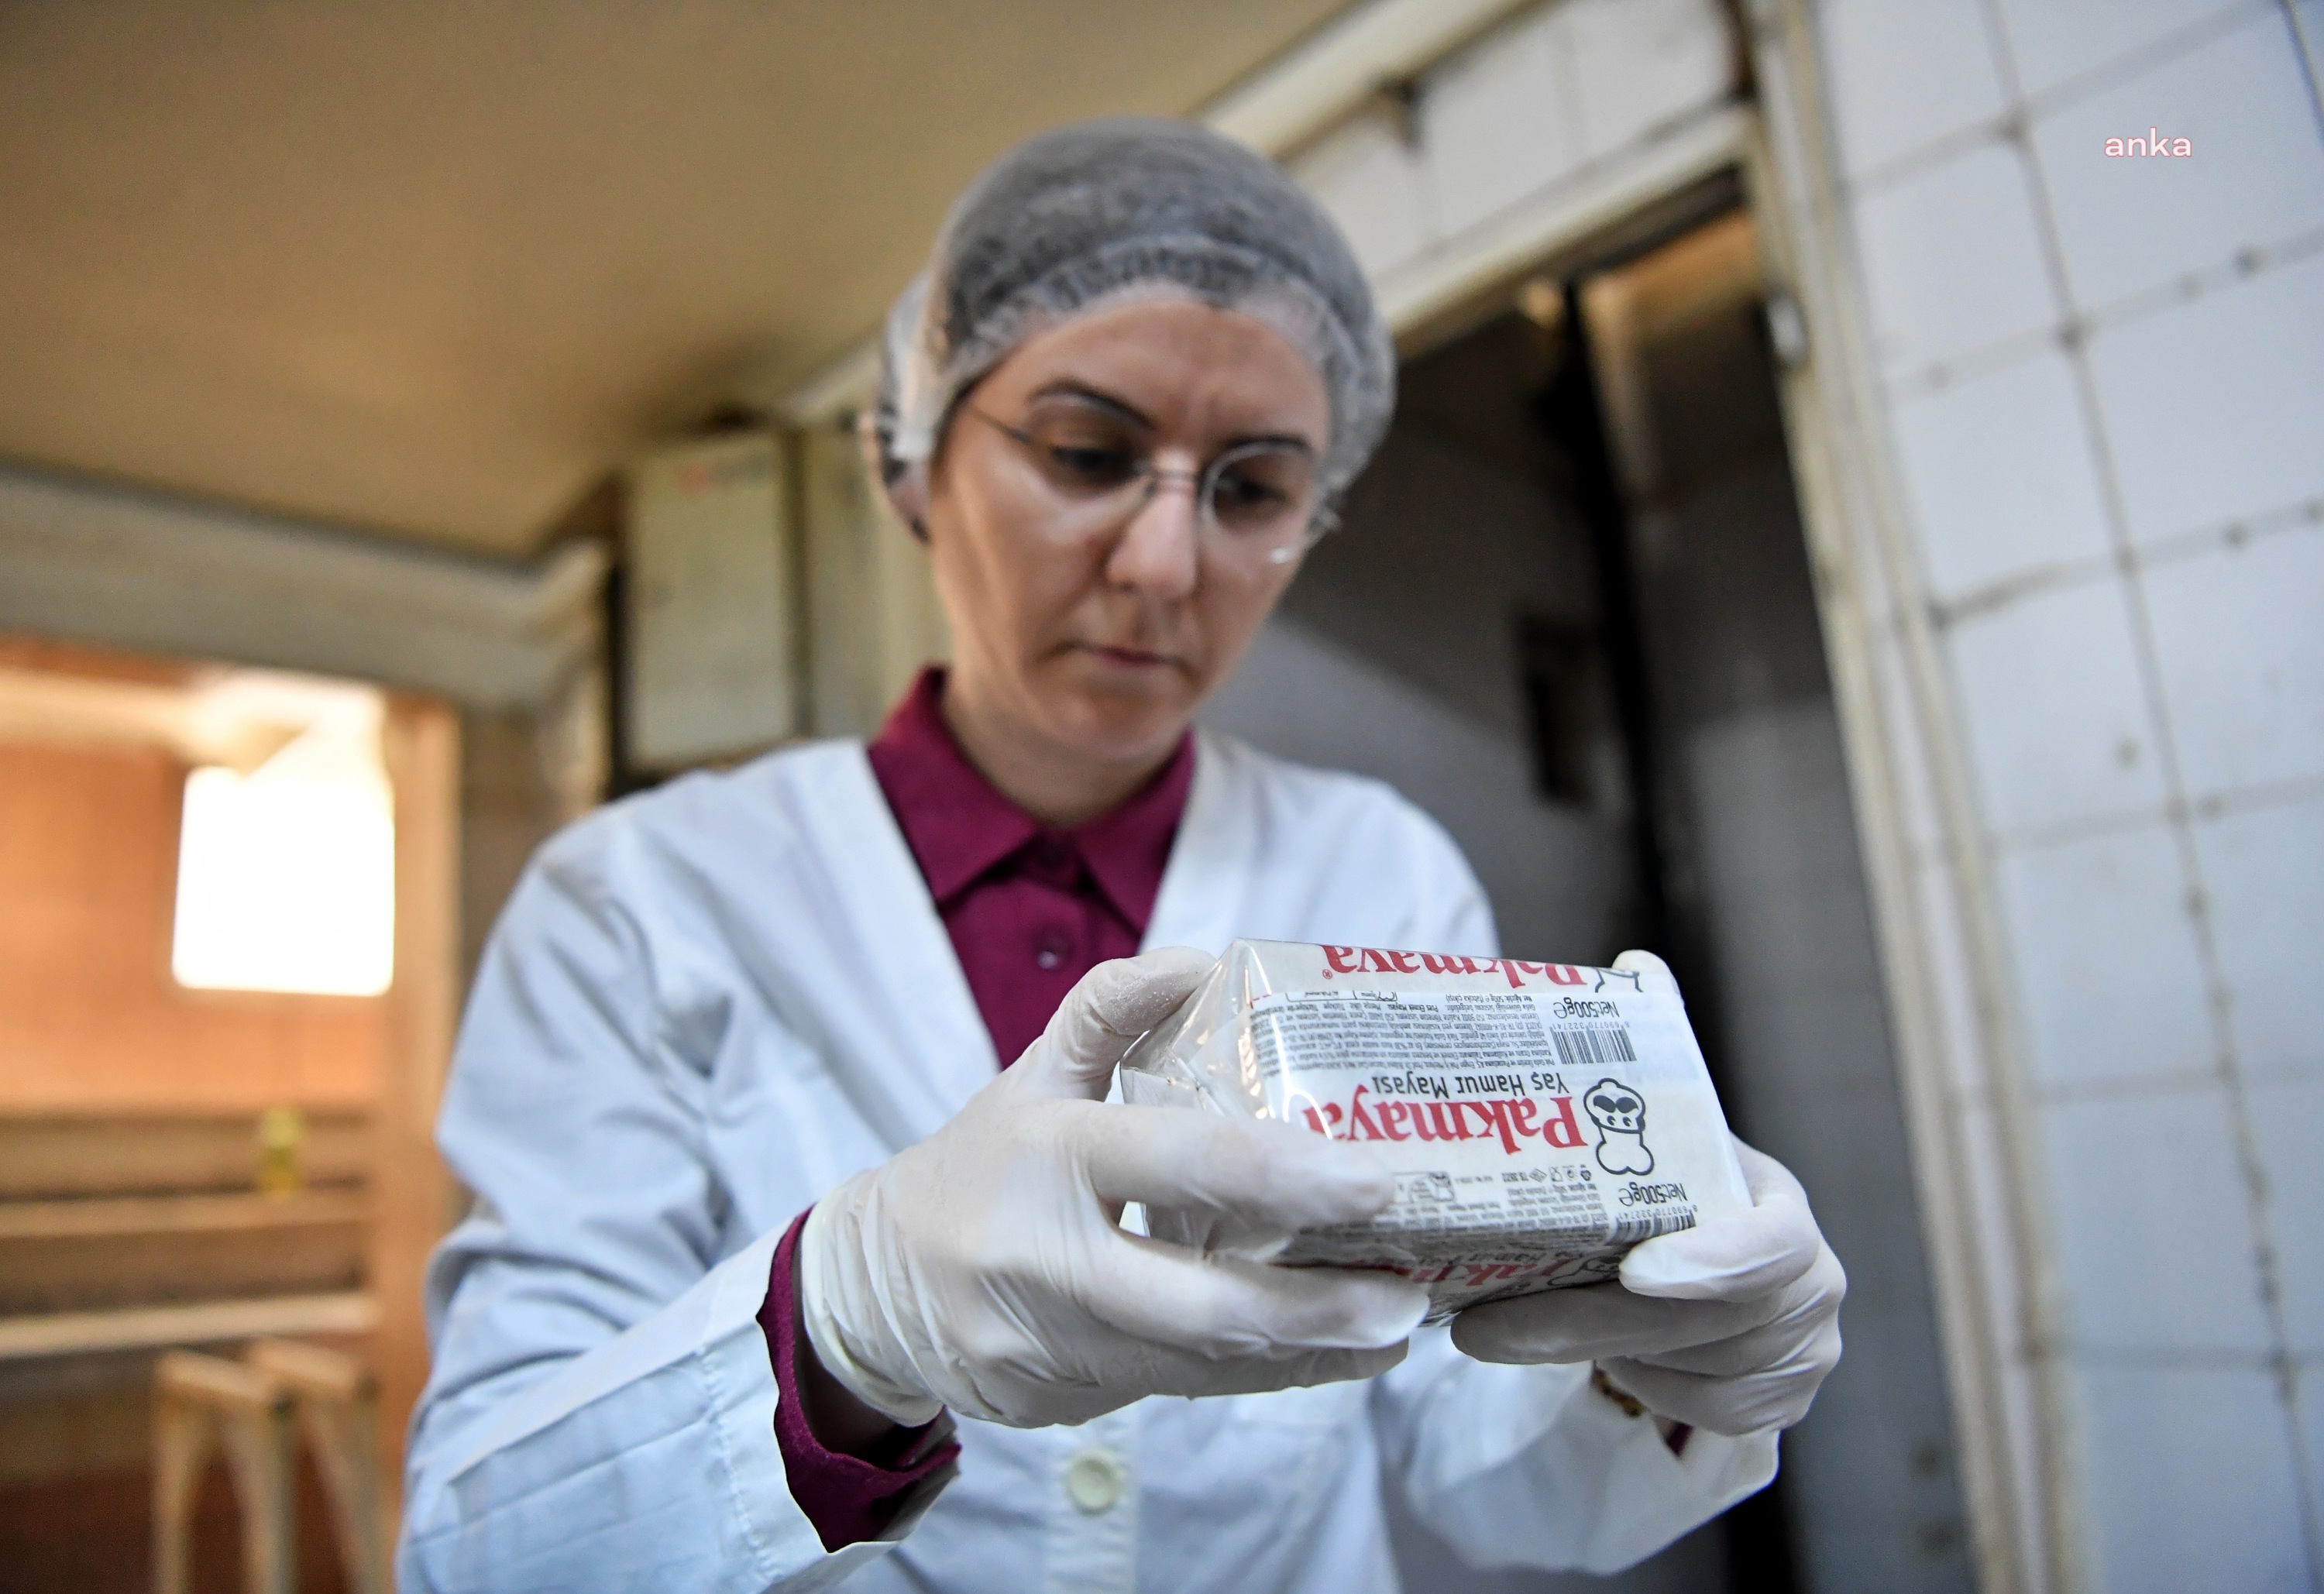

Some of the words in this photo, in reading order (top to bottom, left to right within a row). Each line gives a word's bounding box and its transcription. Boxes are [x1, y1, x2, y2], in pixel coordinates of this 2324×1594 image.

[1372, 1071, 1449, 1099] Mayası
[1457, 1074, 1526, 1097] Hamur
[1532, 1071, 1569, 1094] Yaş
